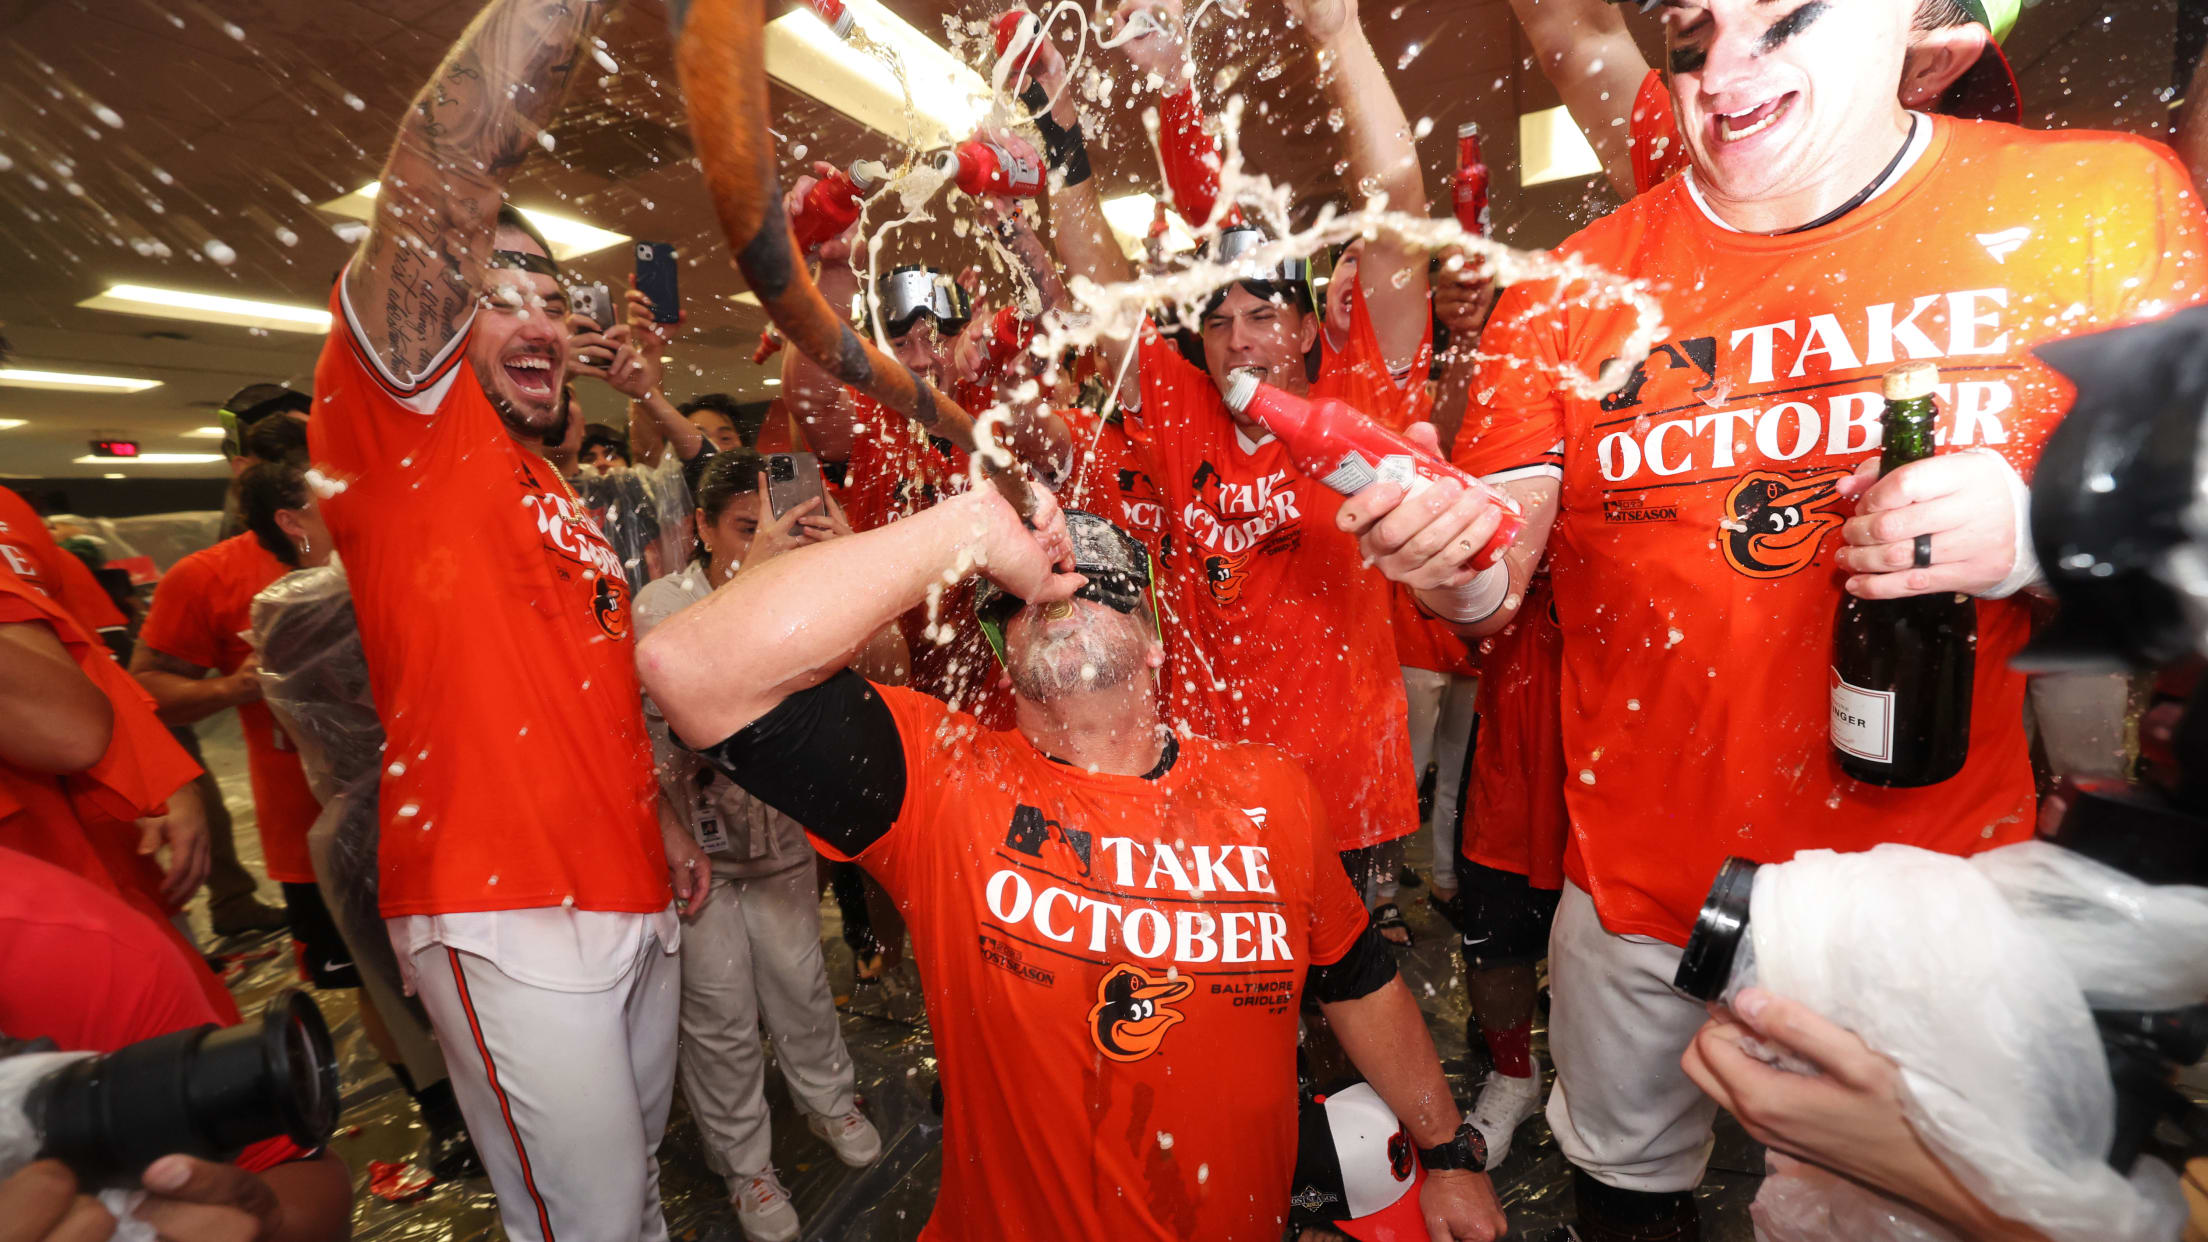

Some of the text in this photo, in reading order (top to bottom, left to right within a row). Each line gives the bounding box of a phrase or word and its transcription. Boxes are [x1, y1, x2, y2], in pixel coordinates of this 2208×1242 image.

[1731, 288, 2008, 384] TAKE
[1219, 468, 1286, 514] TAK
[1101, 837, 1276, 894] TAKE
[986, 869, 1294, 963] OCTOBER
[1211, 980, 1293, 994] BALTIMORE
